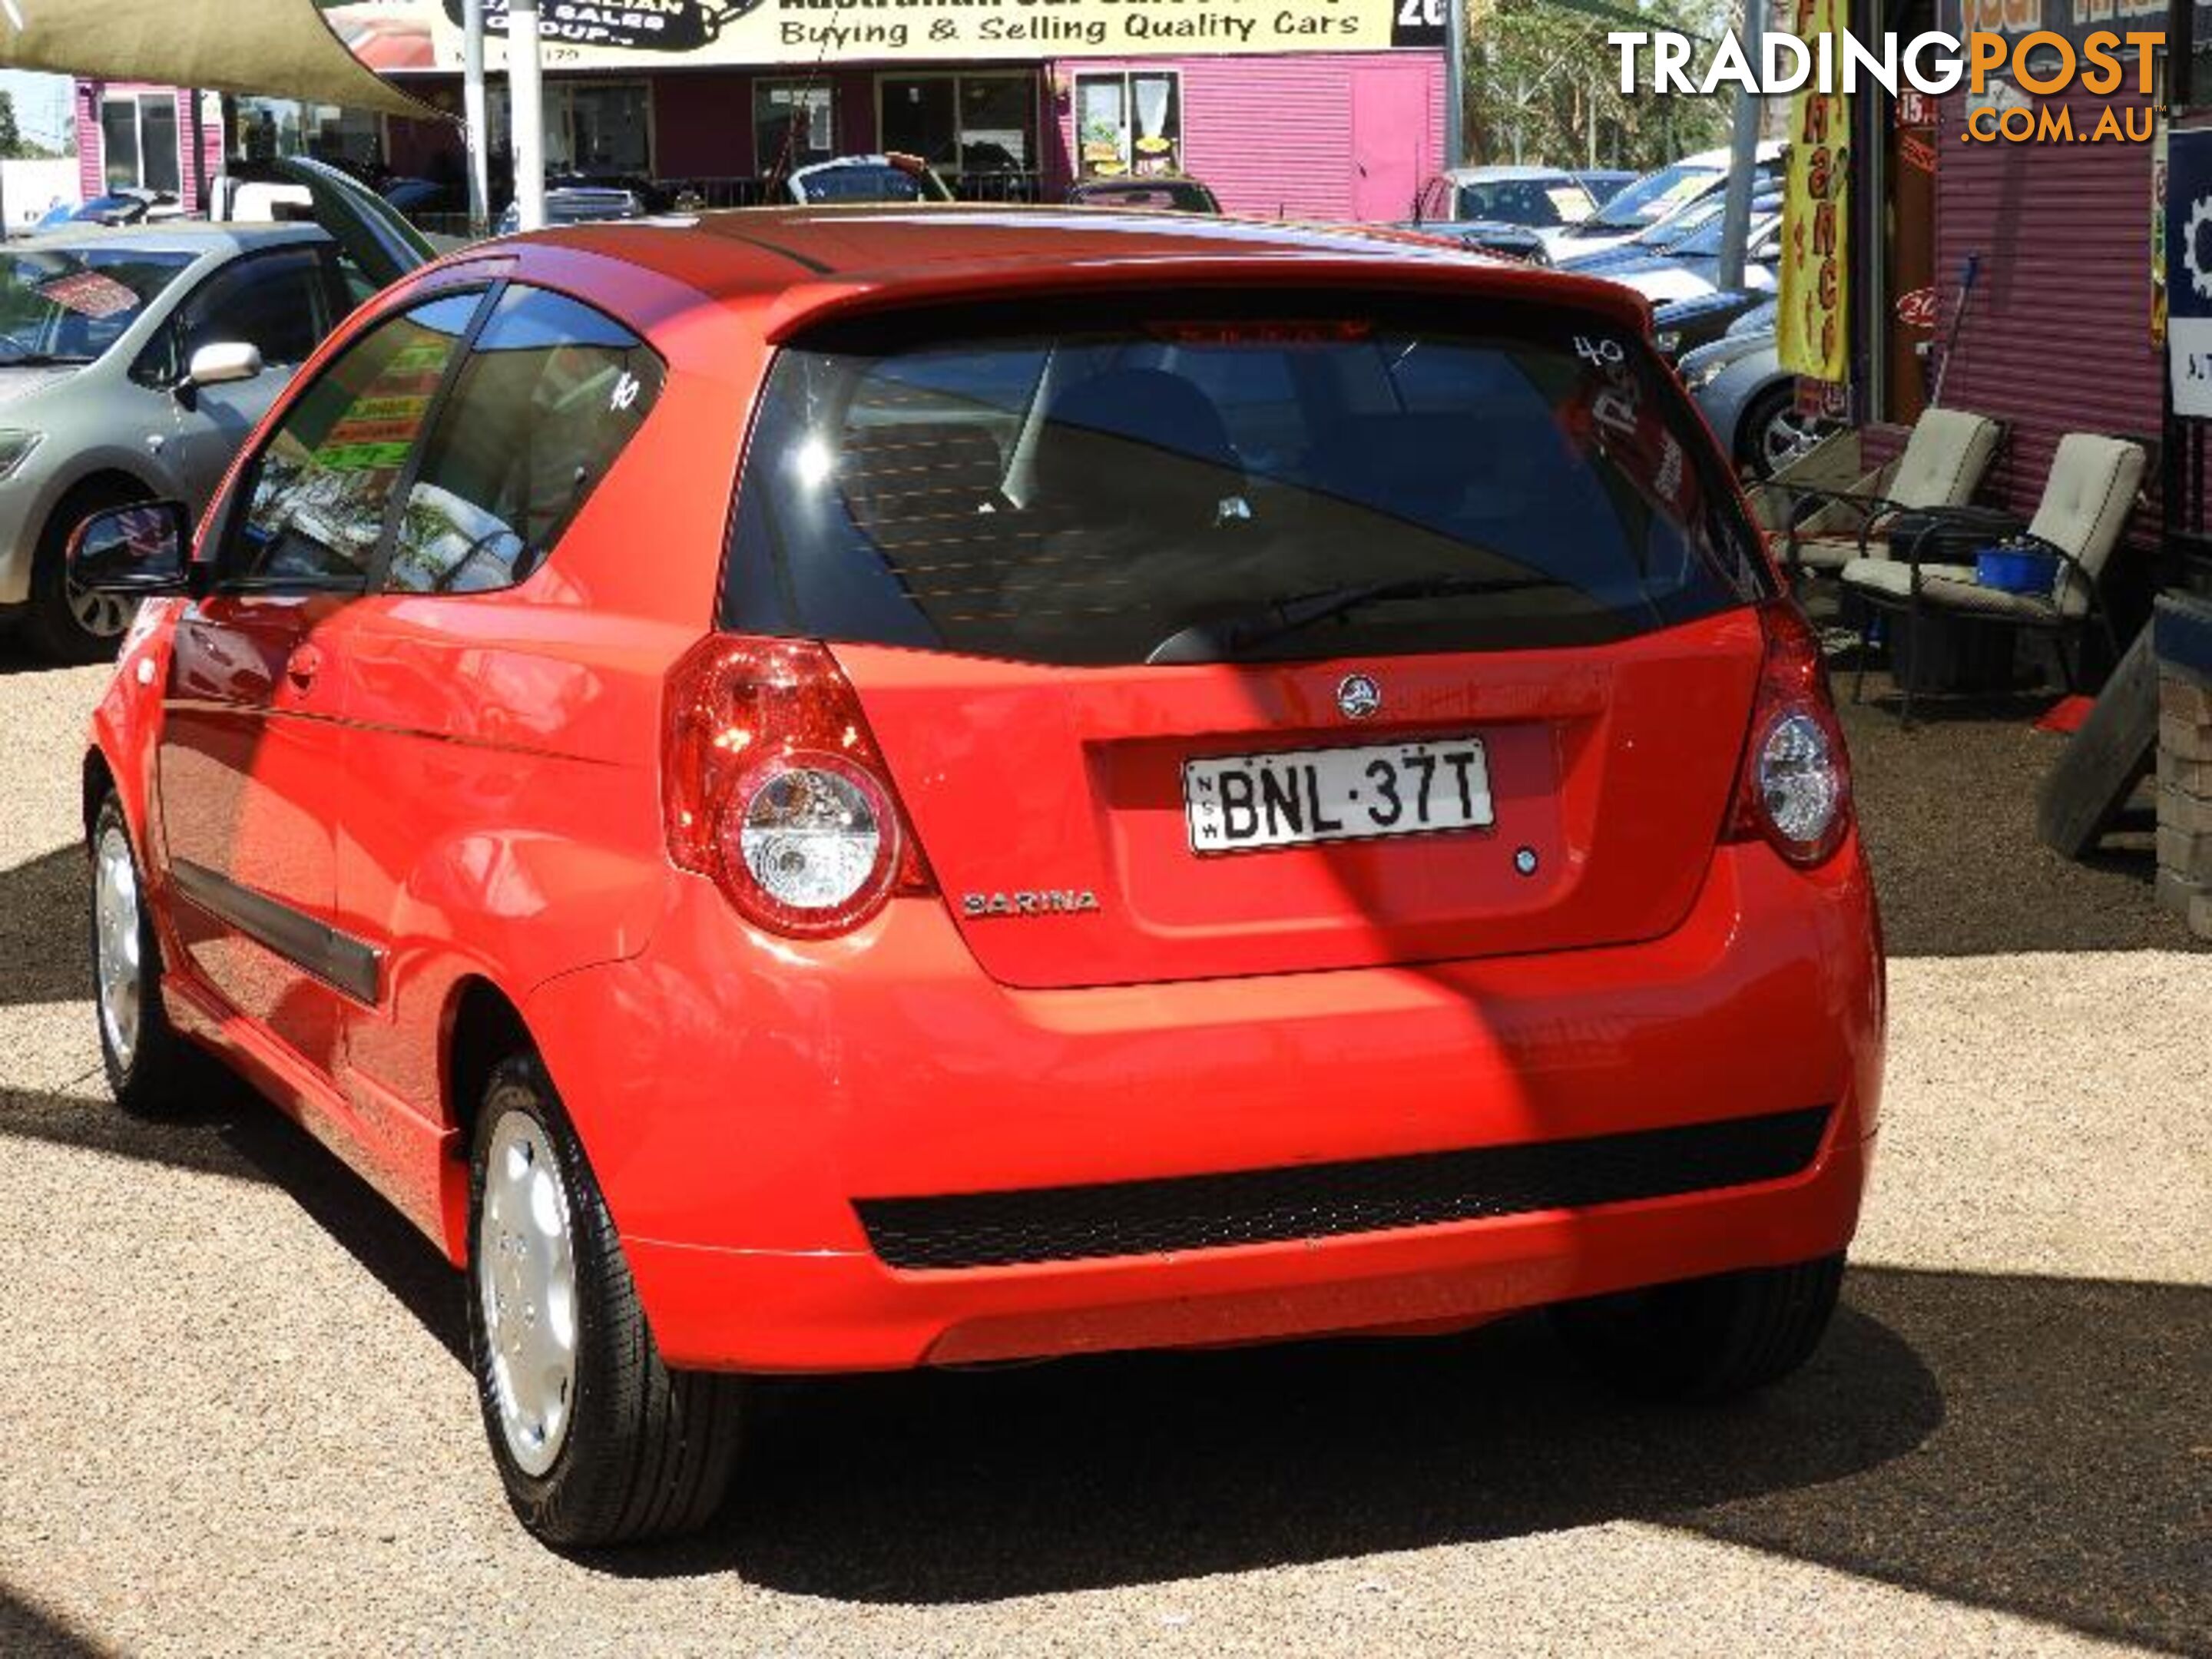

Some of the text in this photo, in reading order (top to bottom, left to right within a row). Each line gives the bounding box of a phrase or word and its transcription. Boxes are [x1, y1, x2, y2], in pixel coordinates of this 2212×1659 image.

[486, 15, 609, 39] GOUP
[780, 10, 1359, 49] Buying & Selling Quality Cars
